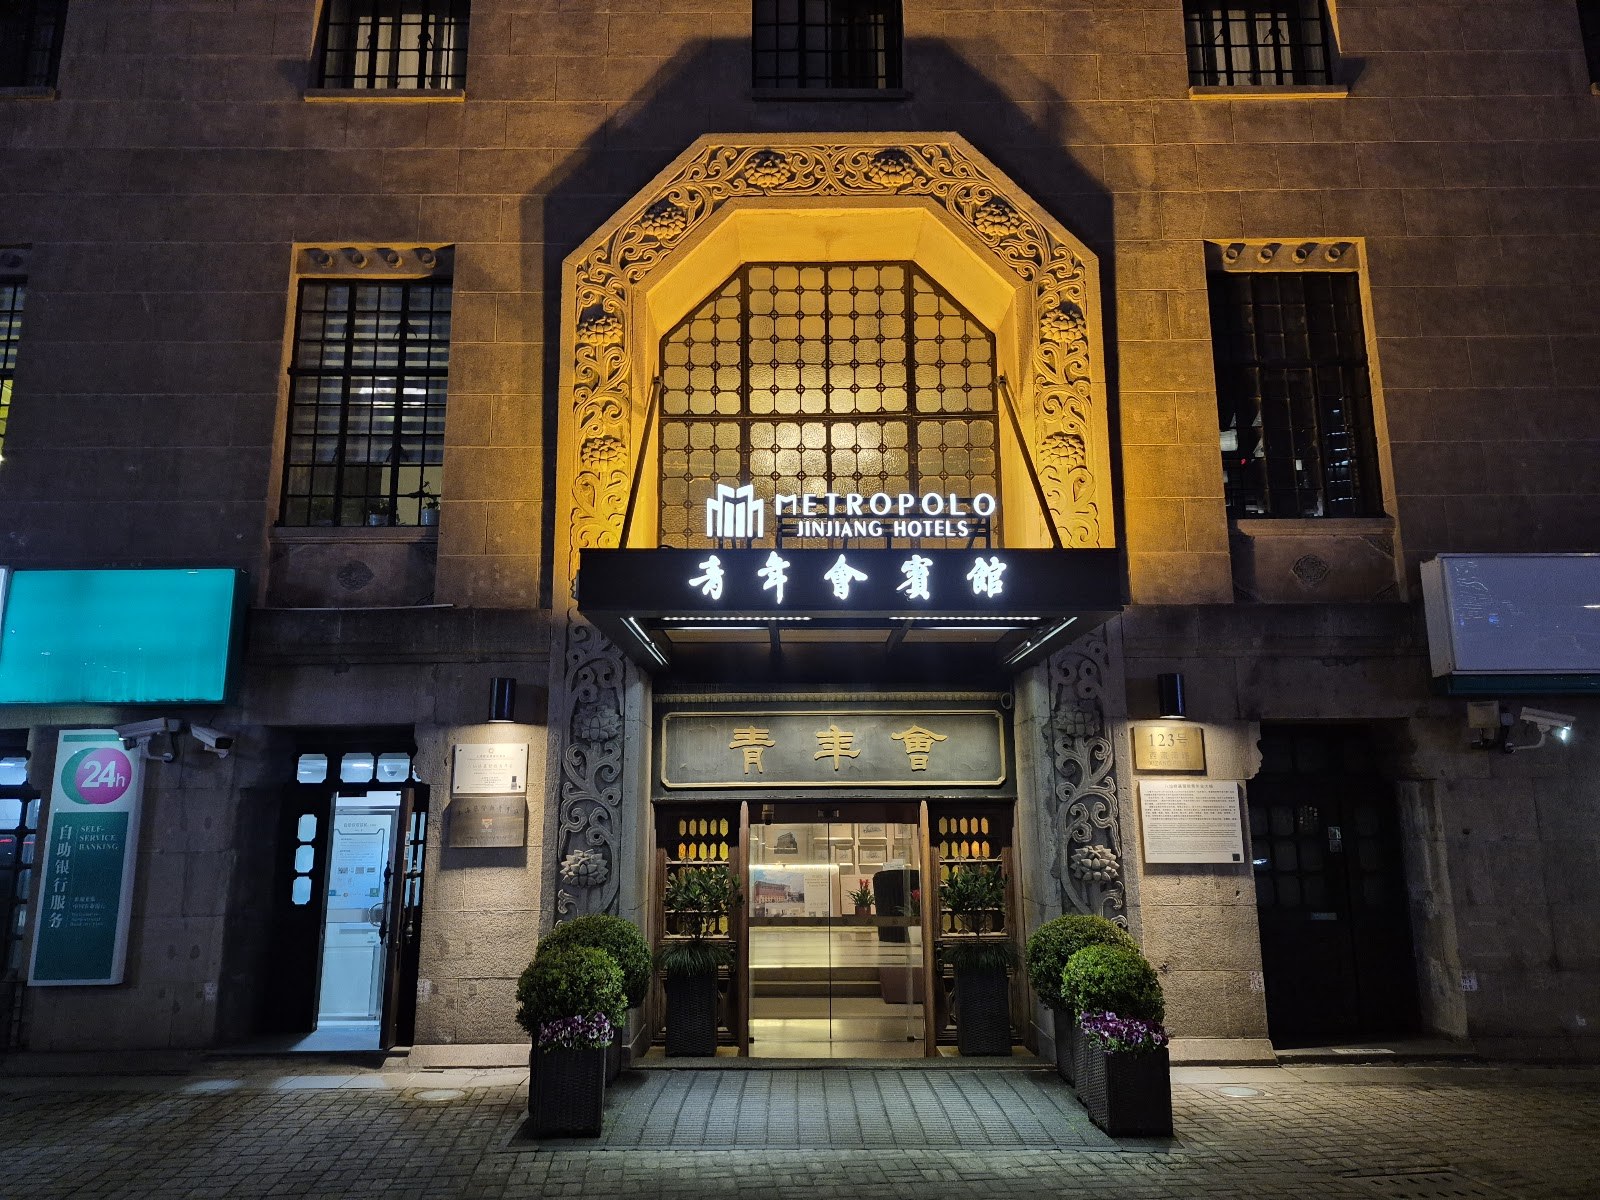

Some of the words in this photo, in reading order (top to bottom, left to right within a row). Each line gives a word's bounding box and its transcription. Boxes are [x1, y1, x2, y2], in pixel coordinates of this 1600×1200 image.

[775, 492, 996, 516] METROPOLO
[797, 520, 883, 537] JINJIANG
[893, 520, 969, 537] HOTELS
[688, 551, 1007, 604] 青年會賓館
[729, 724, 949, 774] 青年會
[1148, 733, 1189, 747] 123号
[81, 760, 125, 788] 24h
[79, 834, 116, 842] SERVICE
[80, 825, 105, 833] SELF-
[78, 843, 119, 851] BANKING
[48, 824, 72, 929] 自助银行服务
